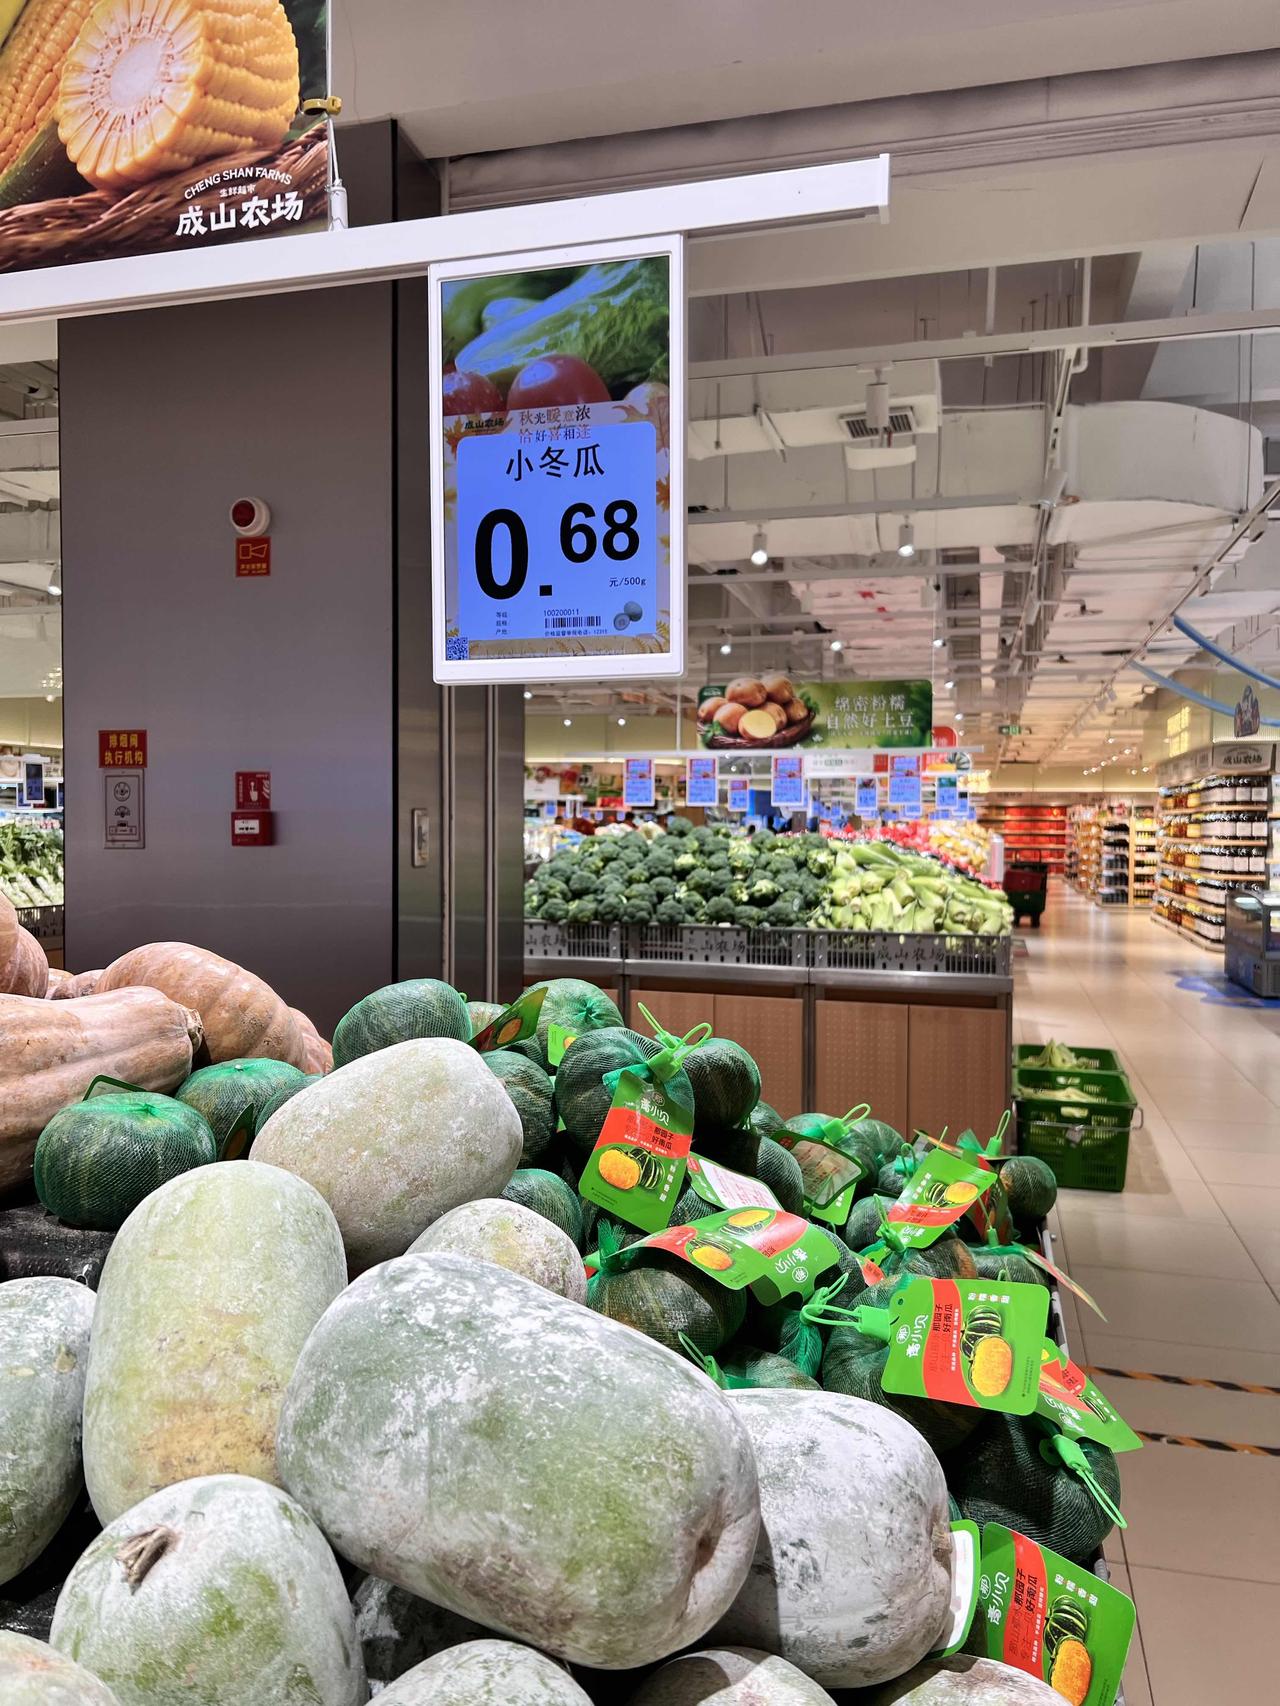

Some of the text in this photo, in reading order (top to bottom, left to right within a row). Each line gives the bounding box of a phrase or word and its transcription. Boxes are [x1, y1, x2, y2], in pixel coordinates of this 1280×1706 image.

[184, 167, 293, 200] CHENG SHAN FARMS
[175, 191, 304, 236] 成山农场
[464, 417, 505, 430] 成山农场
[519, 404, 591, 426] 秋光暖意浓
[505, 443, 605, 482] 小冬瓜
[609, 576, 647, 588] 元/500g
[543, 608, 580, 617] 100200011
[834, 694, 905, 713] 绵密粉糯
[825, 712, 915, 730] 自然好土豆
[942, 1303, 954, 1333] 好南瓜
[1025, 1575, 1039, 1614] 好南瓜
